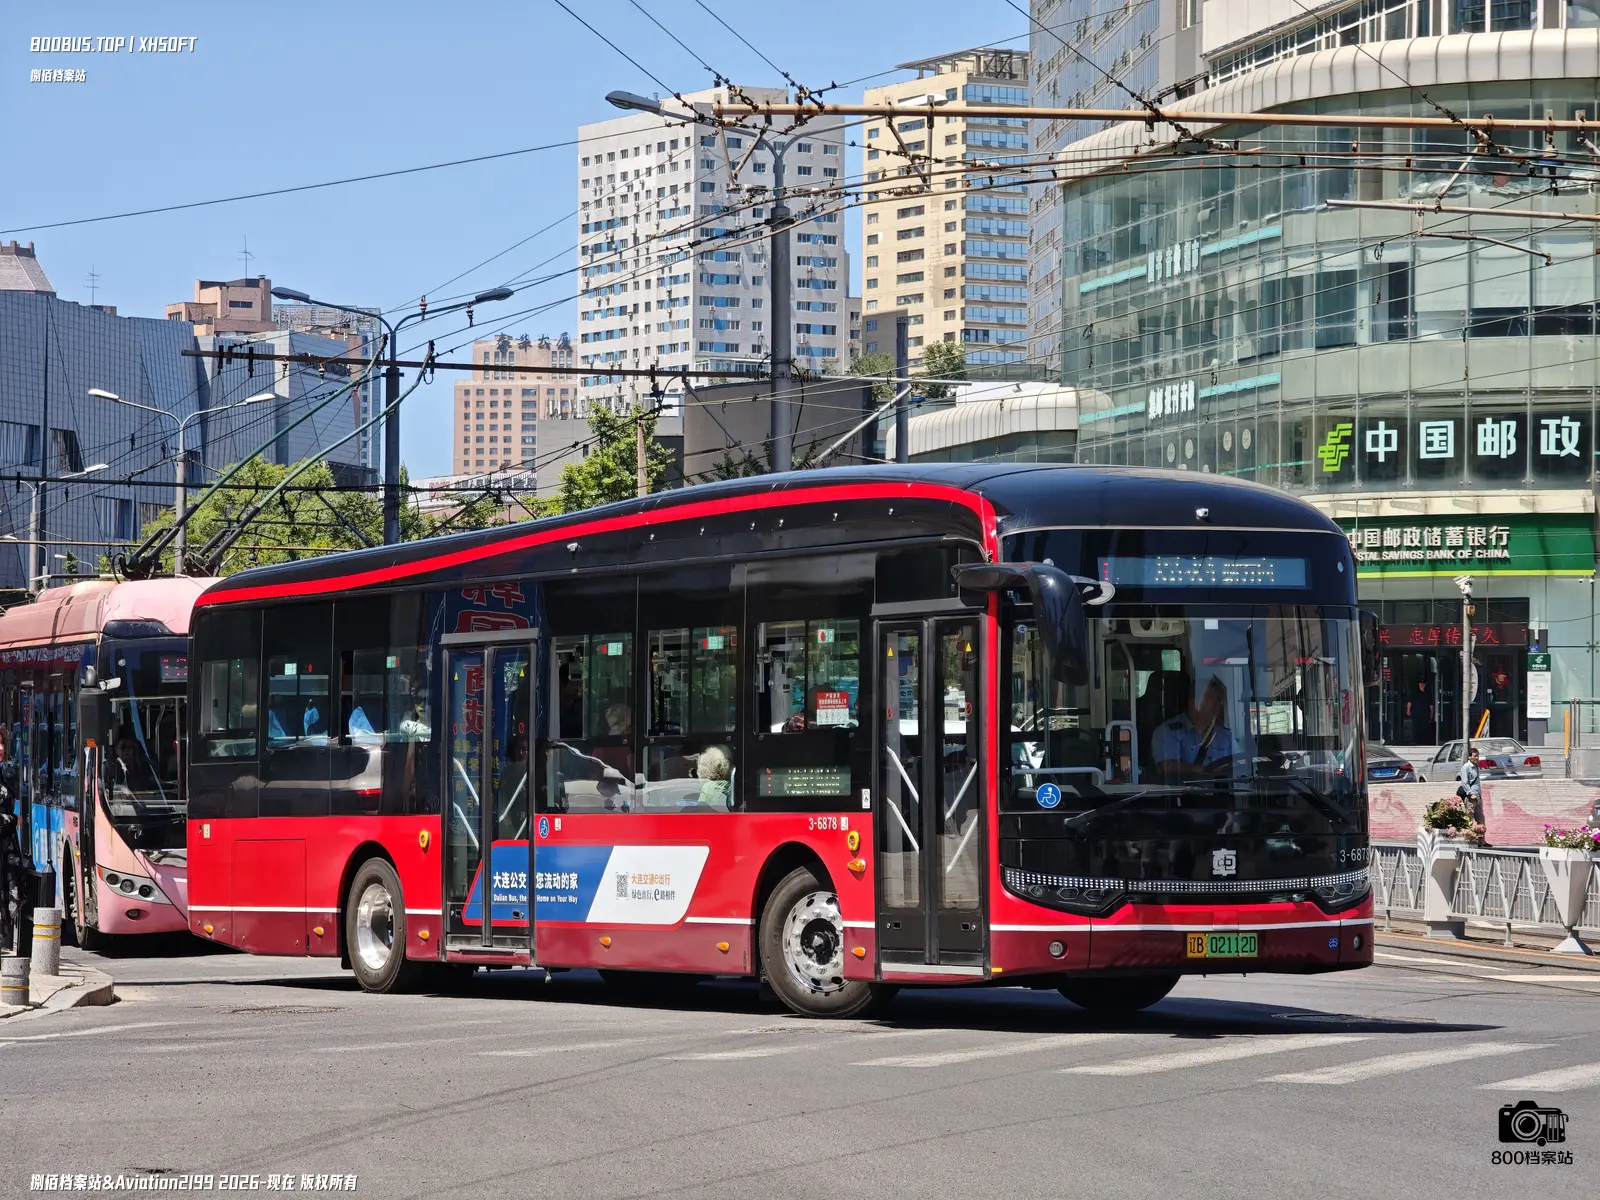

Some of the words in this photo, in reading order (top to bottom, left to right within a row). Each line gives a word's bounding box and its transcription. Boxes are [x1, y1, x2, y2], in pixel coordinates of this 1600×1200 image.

[1365, 416, 1581, 463] 中国邮政
[1347, 526, 1510, 548] 中国邮政储蓄银行
[1355, 551, 1380, 561] STAL
[1382, 550, 1424, 560] SAVINGS
[1426, 549, 1454, 560] BANK
[1457, 549, 1473, 559] OF
[1475, 548, 1510, 559] CHINA
[1409, 627, 1500, 646] 忠厚传久
[808, 816, 838, 831] 3-6878
[493, 872, 527, 889] 大连公交
[535, 872, 578, 890] 您流动的家
[493, 893, 508, 902] Dalian
[508, 894, 519, 903] Bus,
[519, 894, 527, 902] the
[536, 895, 549, 903] Home
[557, 895, 568, 903] Your
[568, 895, 578, 904] Way
[1210, 936, 1257, 954] 02112D
